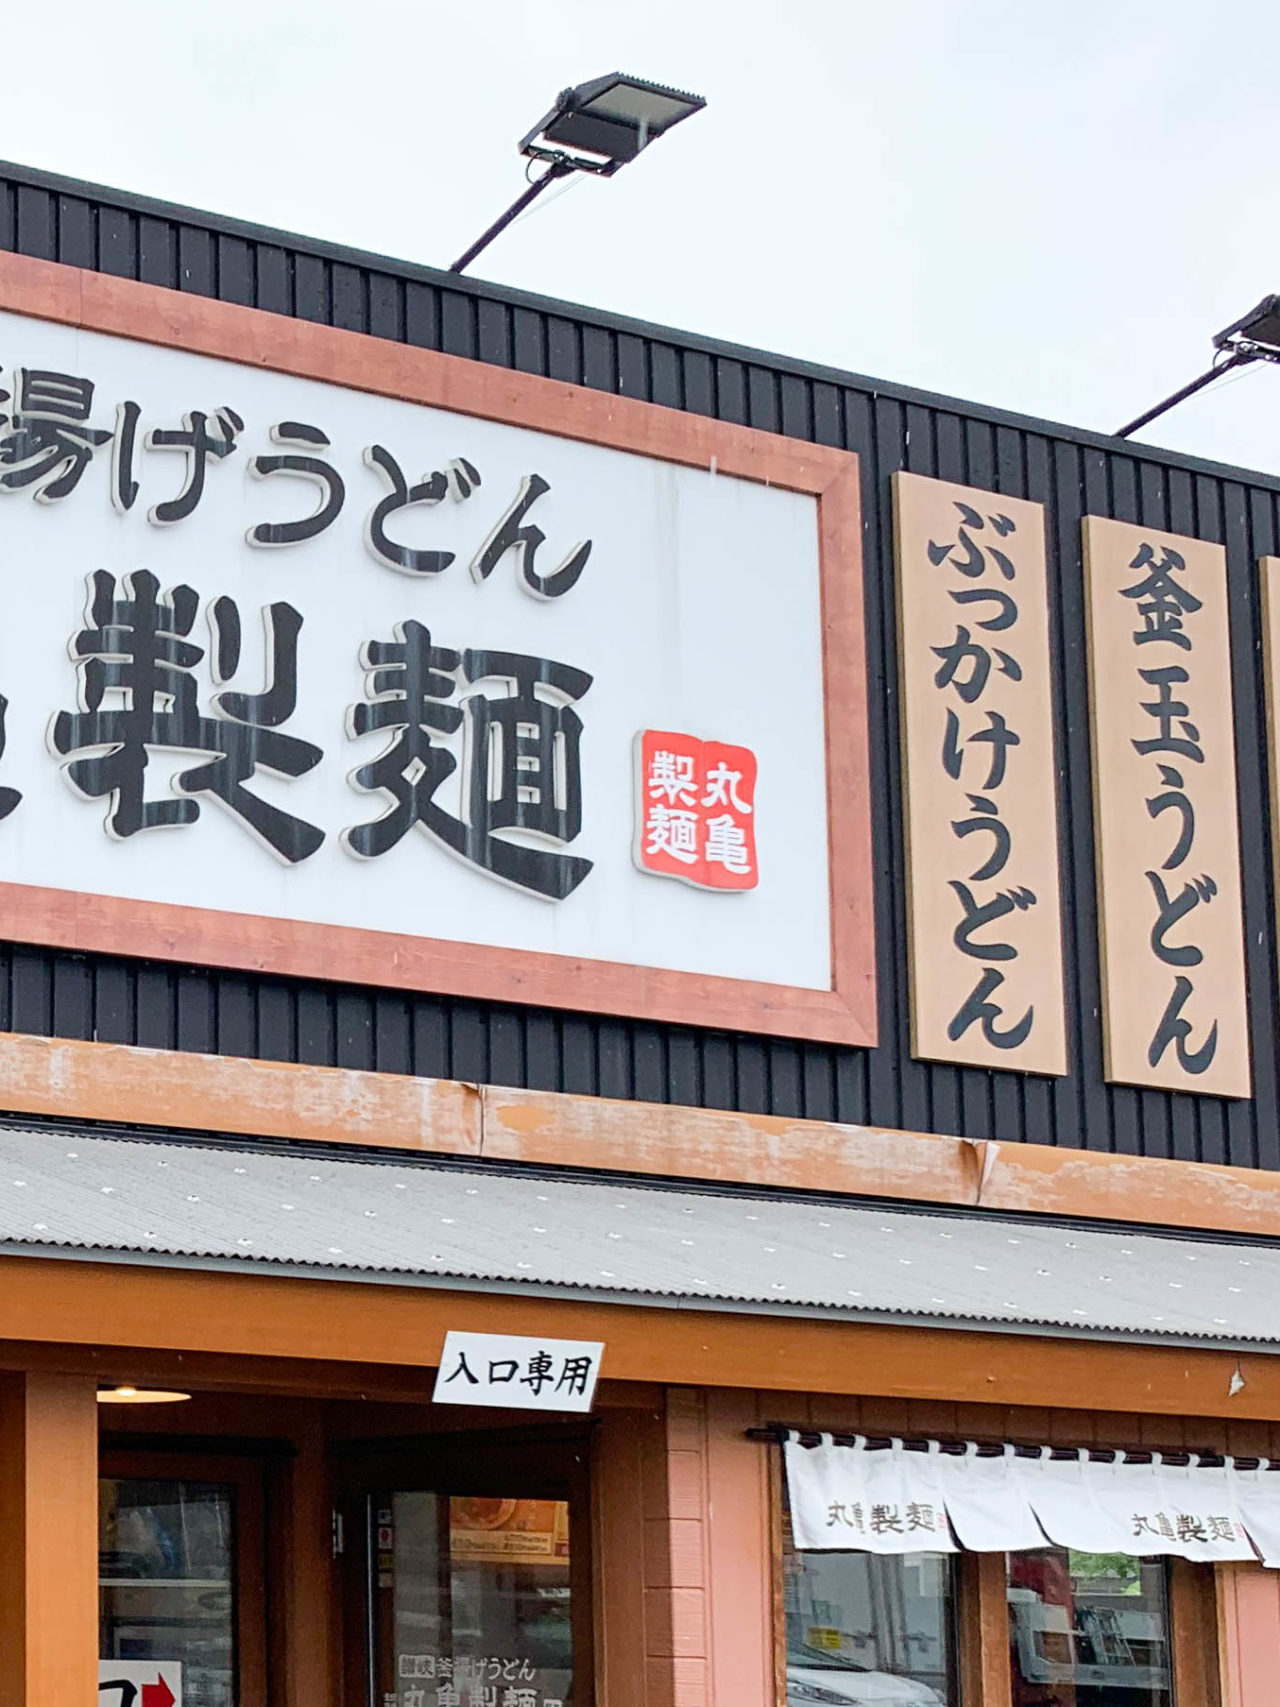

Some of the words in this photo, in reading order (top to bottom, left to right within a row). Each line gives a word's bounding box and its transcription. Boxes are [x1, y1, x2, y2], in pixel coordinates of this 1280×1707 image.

[645, 750, 700, 865] 製麺
[700, 761, 753, 875] 丸亀
[927, 501, 1037, 1050] ぶっかけうどん
[1118, 542, 1219, 1075] 釜玉うどん
[444, 1350, 593, 1396] 入口専用
[826, 1500, 936, 1535] 丸亀製麺
[1131, 1512, 1236, 1543] 丸亀製麺
